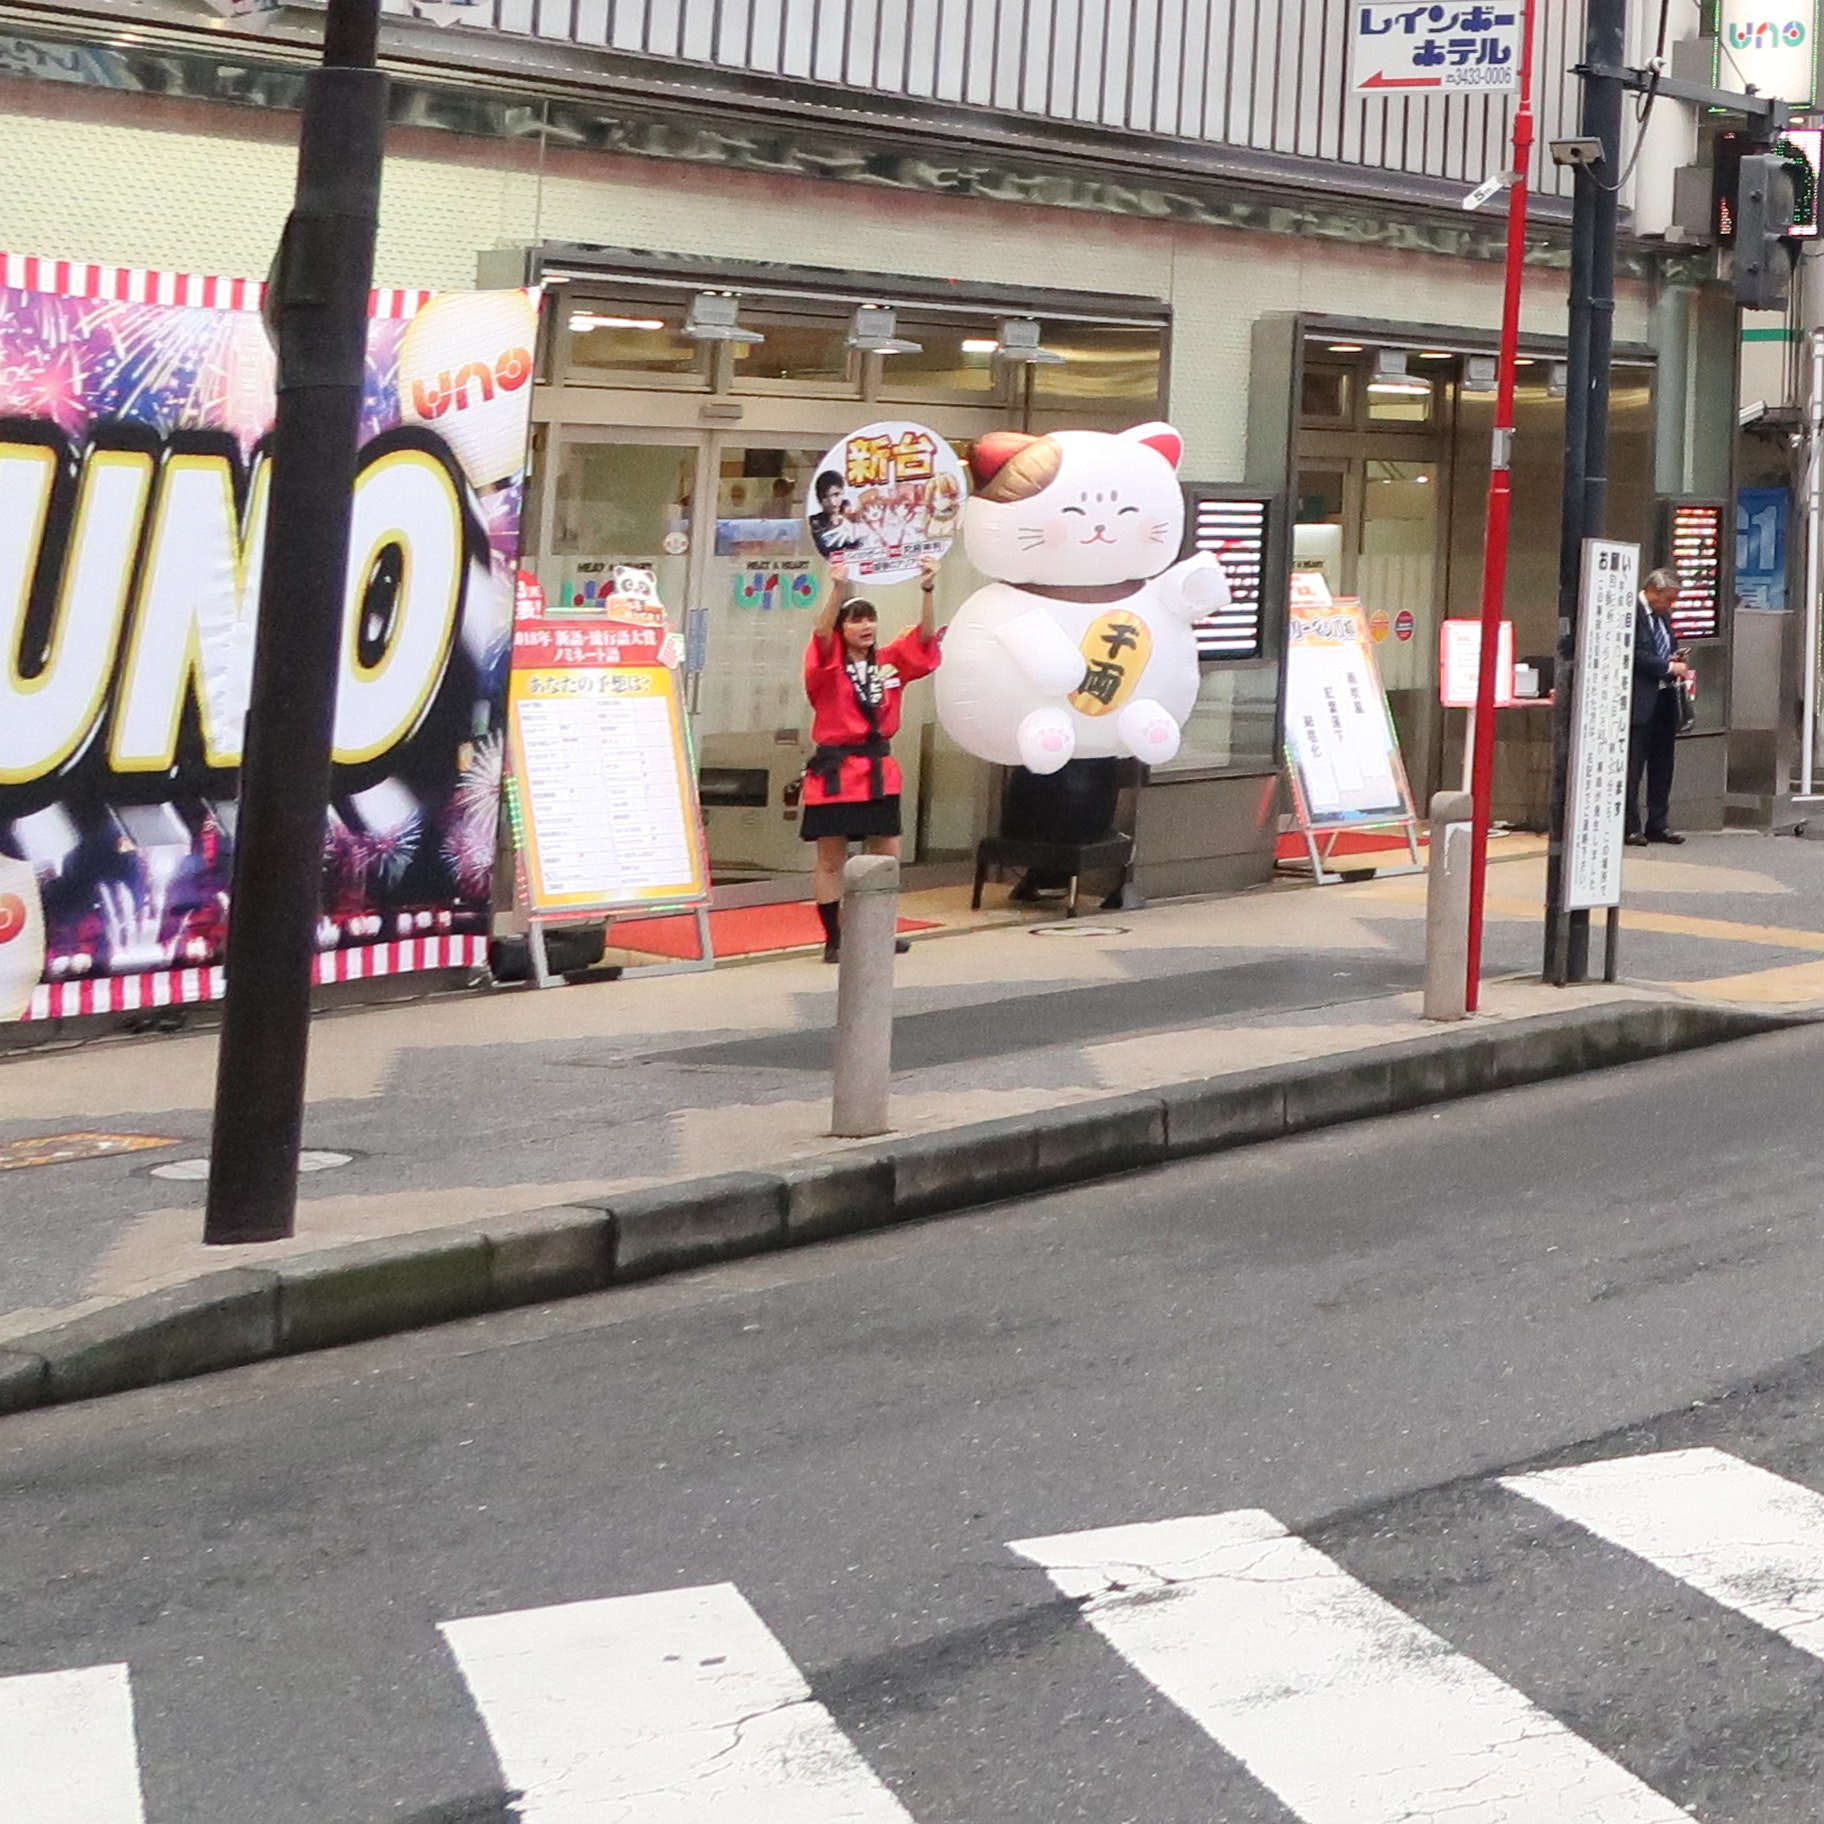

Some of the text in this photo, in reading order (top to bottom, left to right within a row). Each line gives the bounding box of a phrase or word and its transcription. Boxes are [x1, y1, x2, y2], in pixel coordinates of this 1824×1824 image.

[1359, 5, 1516, 37] レインボー
[1728, 20, 1806, 50] uno
[1413, 38, 1512, 67] ホテル
[411, 346, 534, 419] uno
[845, 431, 936, 488] 新台
